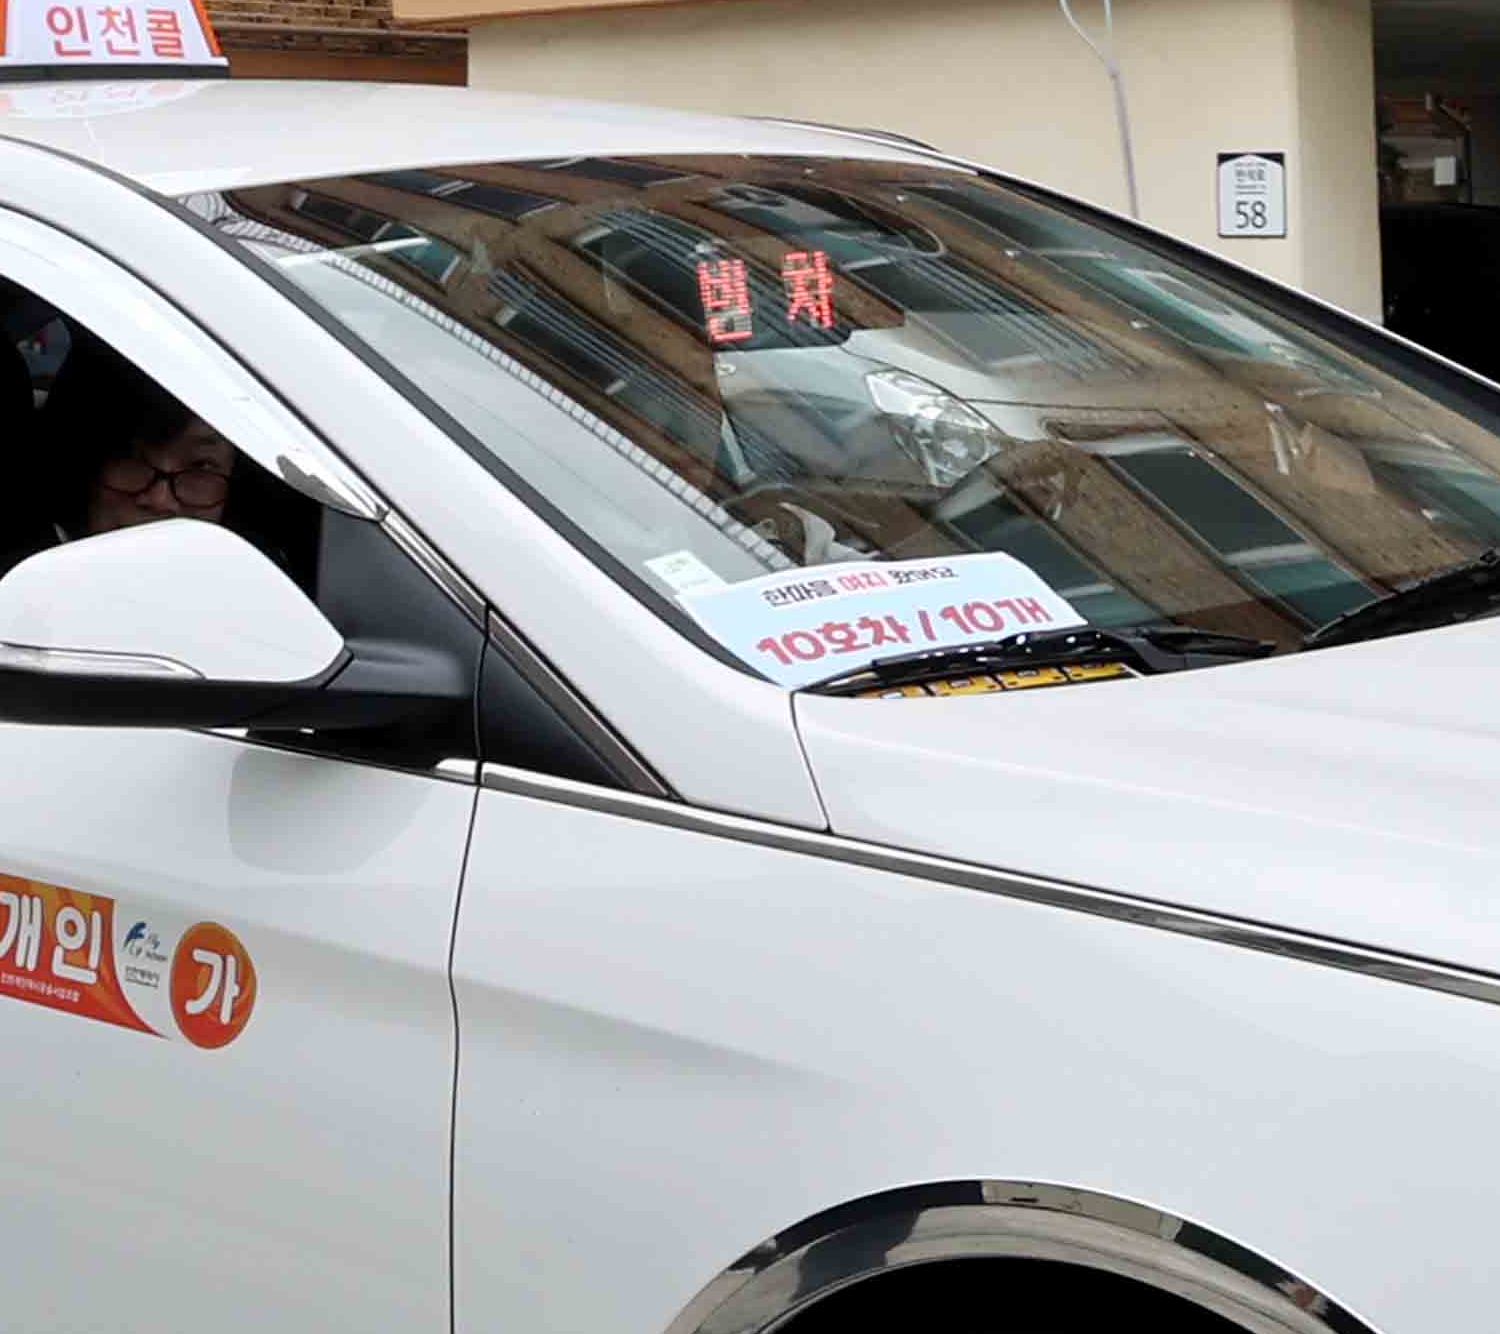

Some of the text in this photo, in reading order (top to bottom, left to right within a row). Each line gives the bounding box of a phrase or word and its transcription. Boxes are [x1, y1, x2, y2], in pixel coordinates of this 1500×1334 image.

[46, 5, 185, 58] 인천콜
[1235, 200, 1267, 229] 58
[757, 615, 911, 665] 10호차
[939, 595, 1053, 635] 10개
[184, 947, 240, 1025] 가
